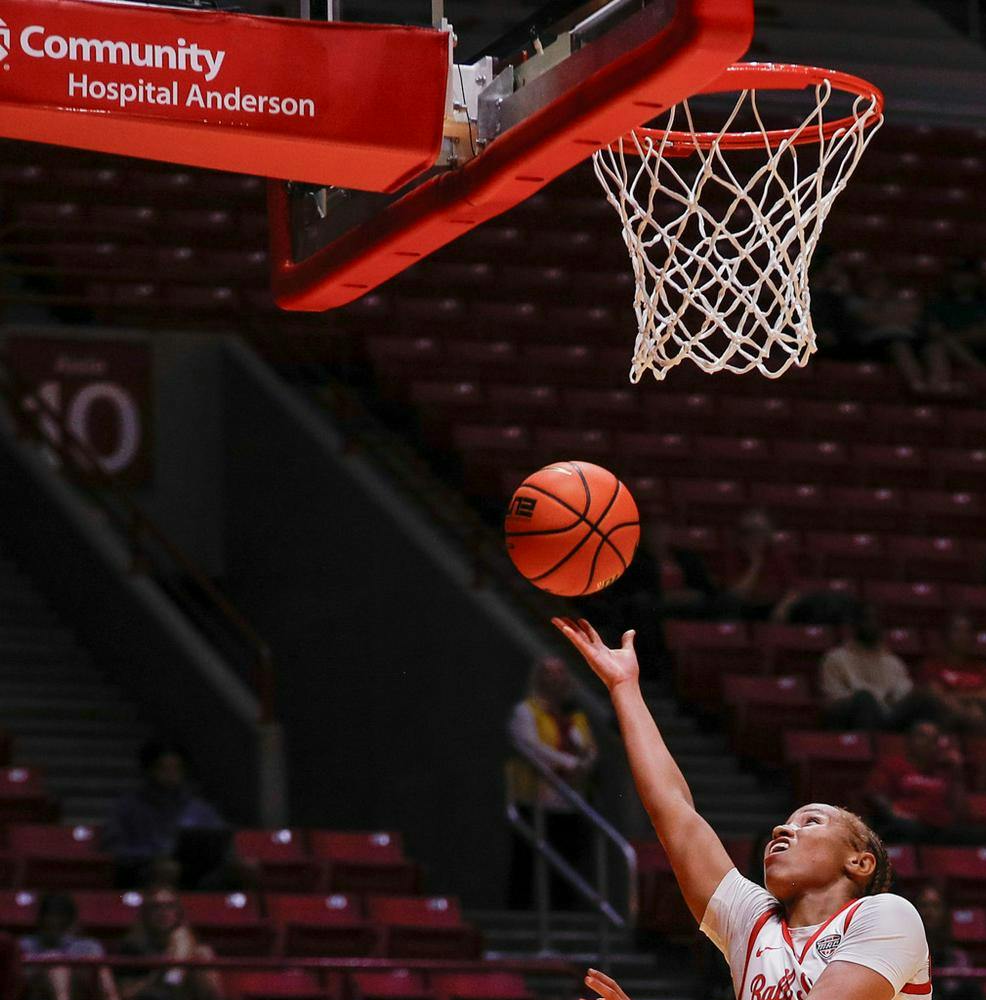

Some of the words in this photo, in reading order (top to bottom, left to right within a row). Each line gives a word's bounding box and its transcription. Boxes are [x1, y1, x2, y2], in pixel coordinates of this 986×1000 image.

[20, 25, 226, 82] Community
[68, 72, 178, 108] Hospital
[186, 83, 316, 117] Anderson
